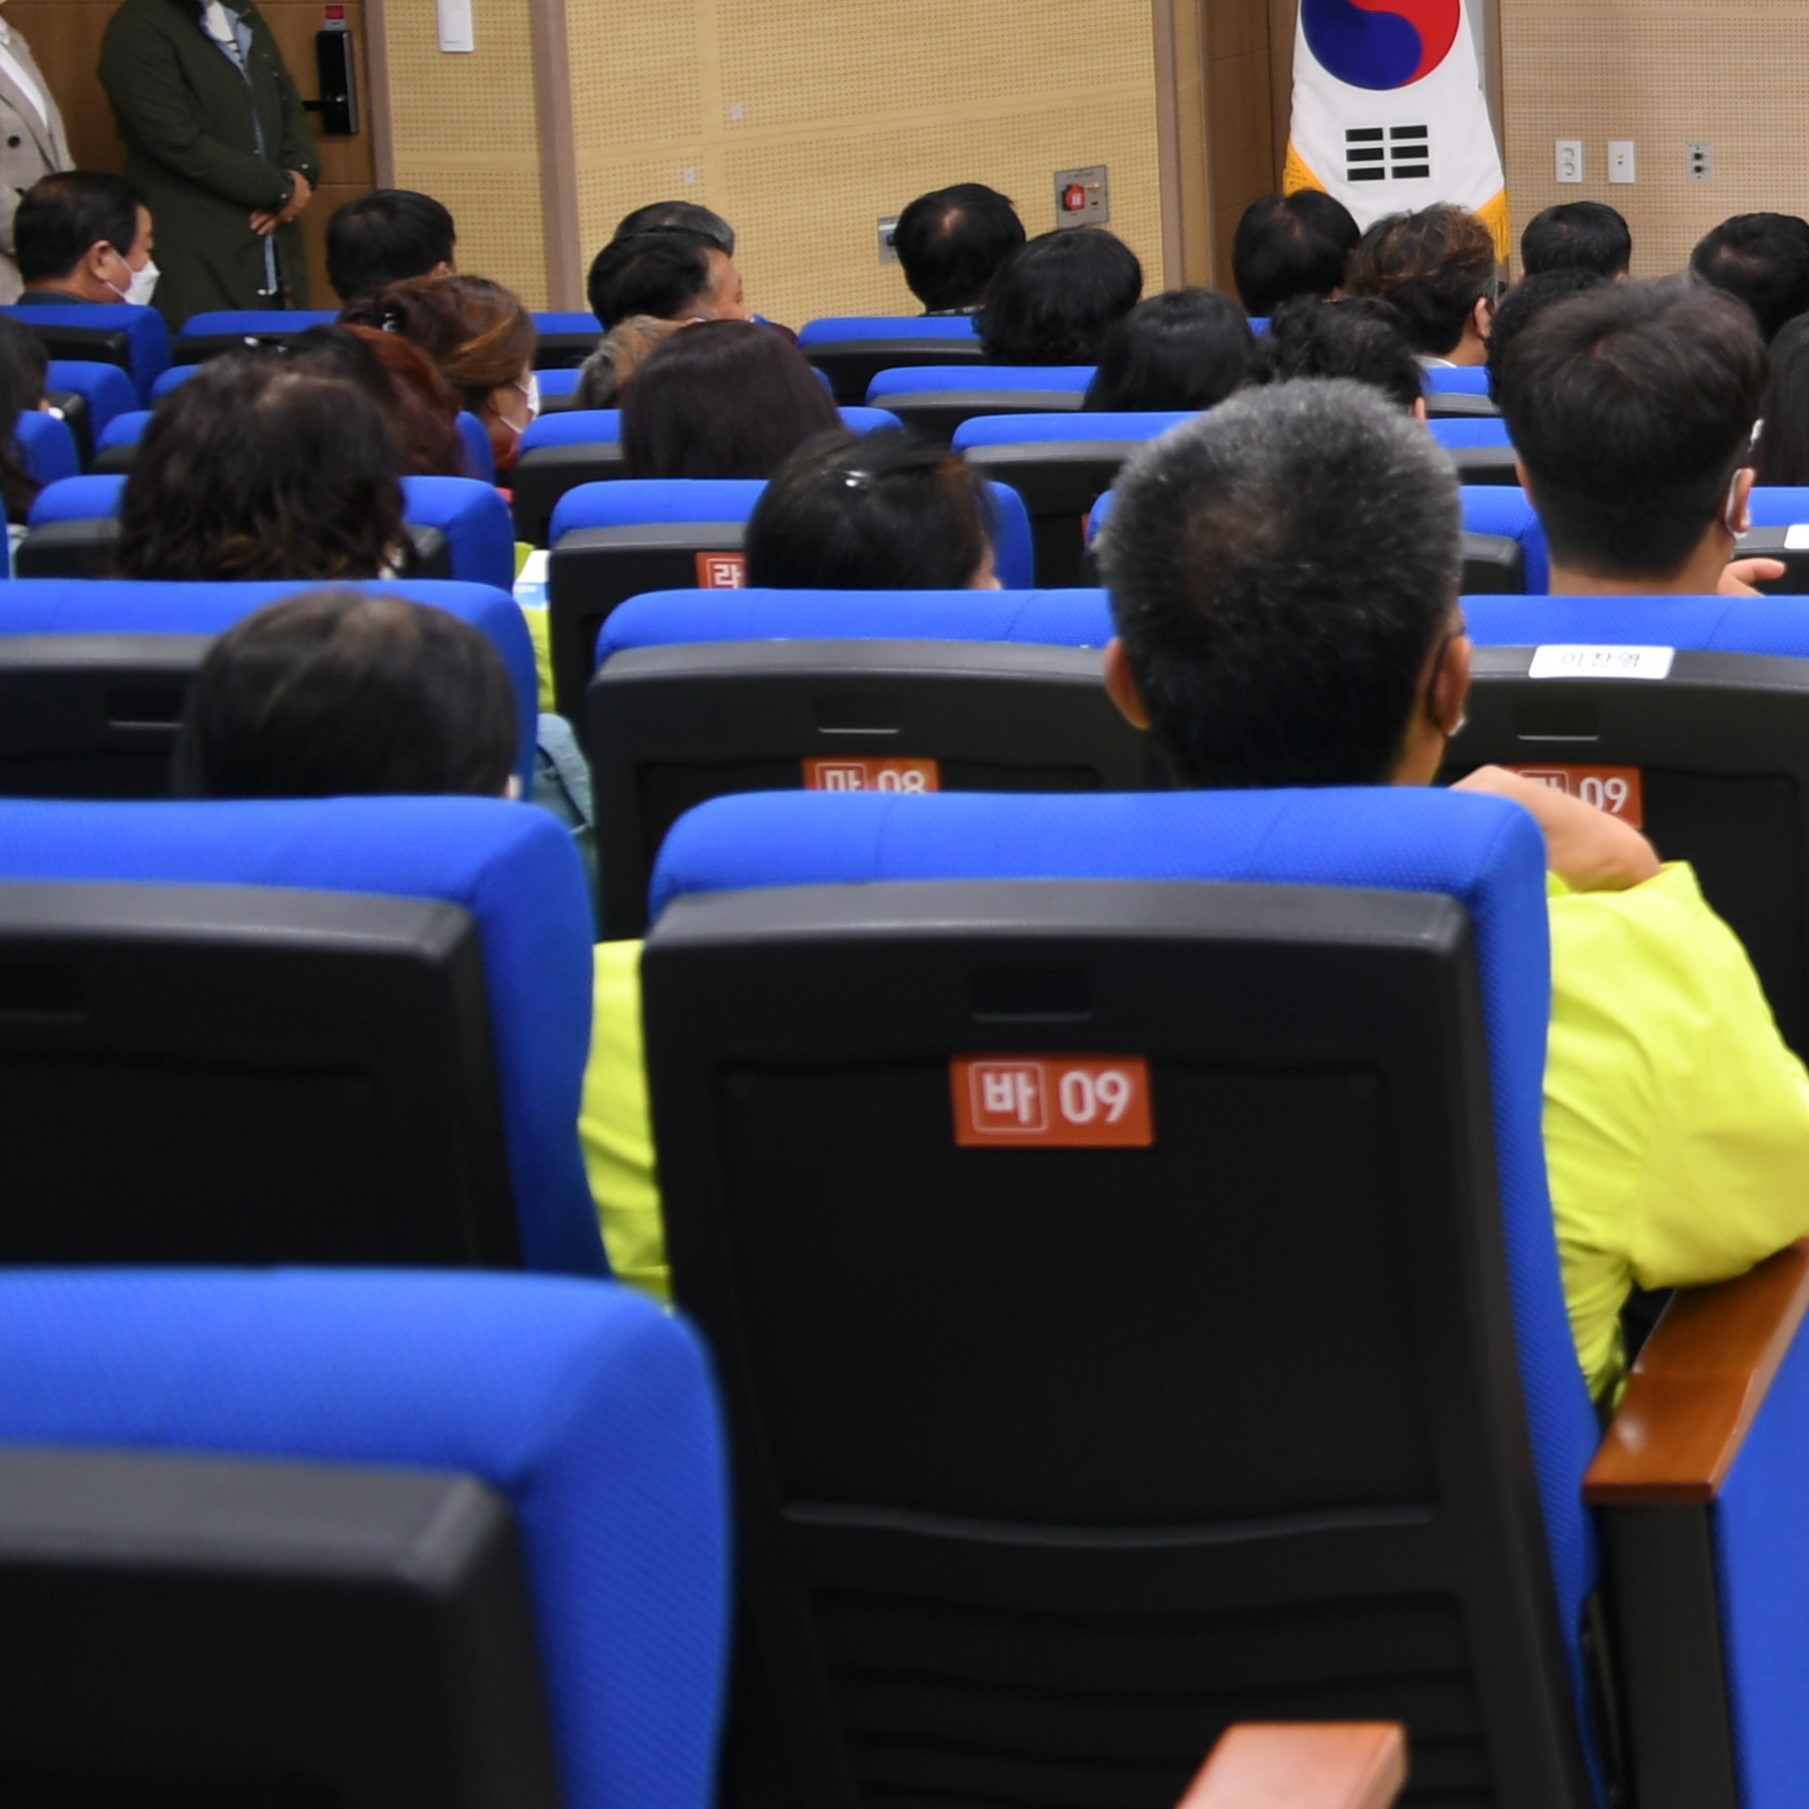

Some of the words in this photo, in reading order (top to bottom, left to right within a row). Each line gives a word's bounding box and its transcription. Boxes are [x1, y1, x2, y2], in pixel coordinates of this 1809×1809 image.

[1579, 776, 1629, 813] 09
[983, 1071, 1036, 1124] 바
[1059, 1071, 1130, 1125] 09
